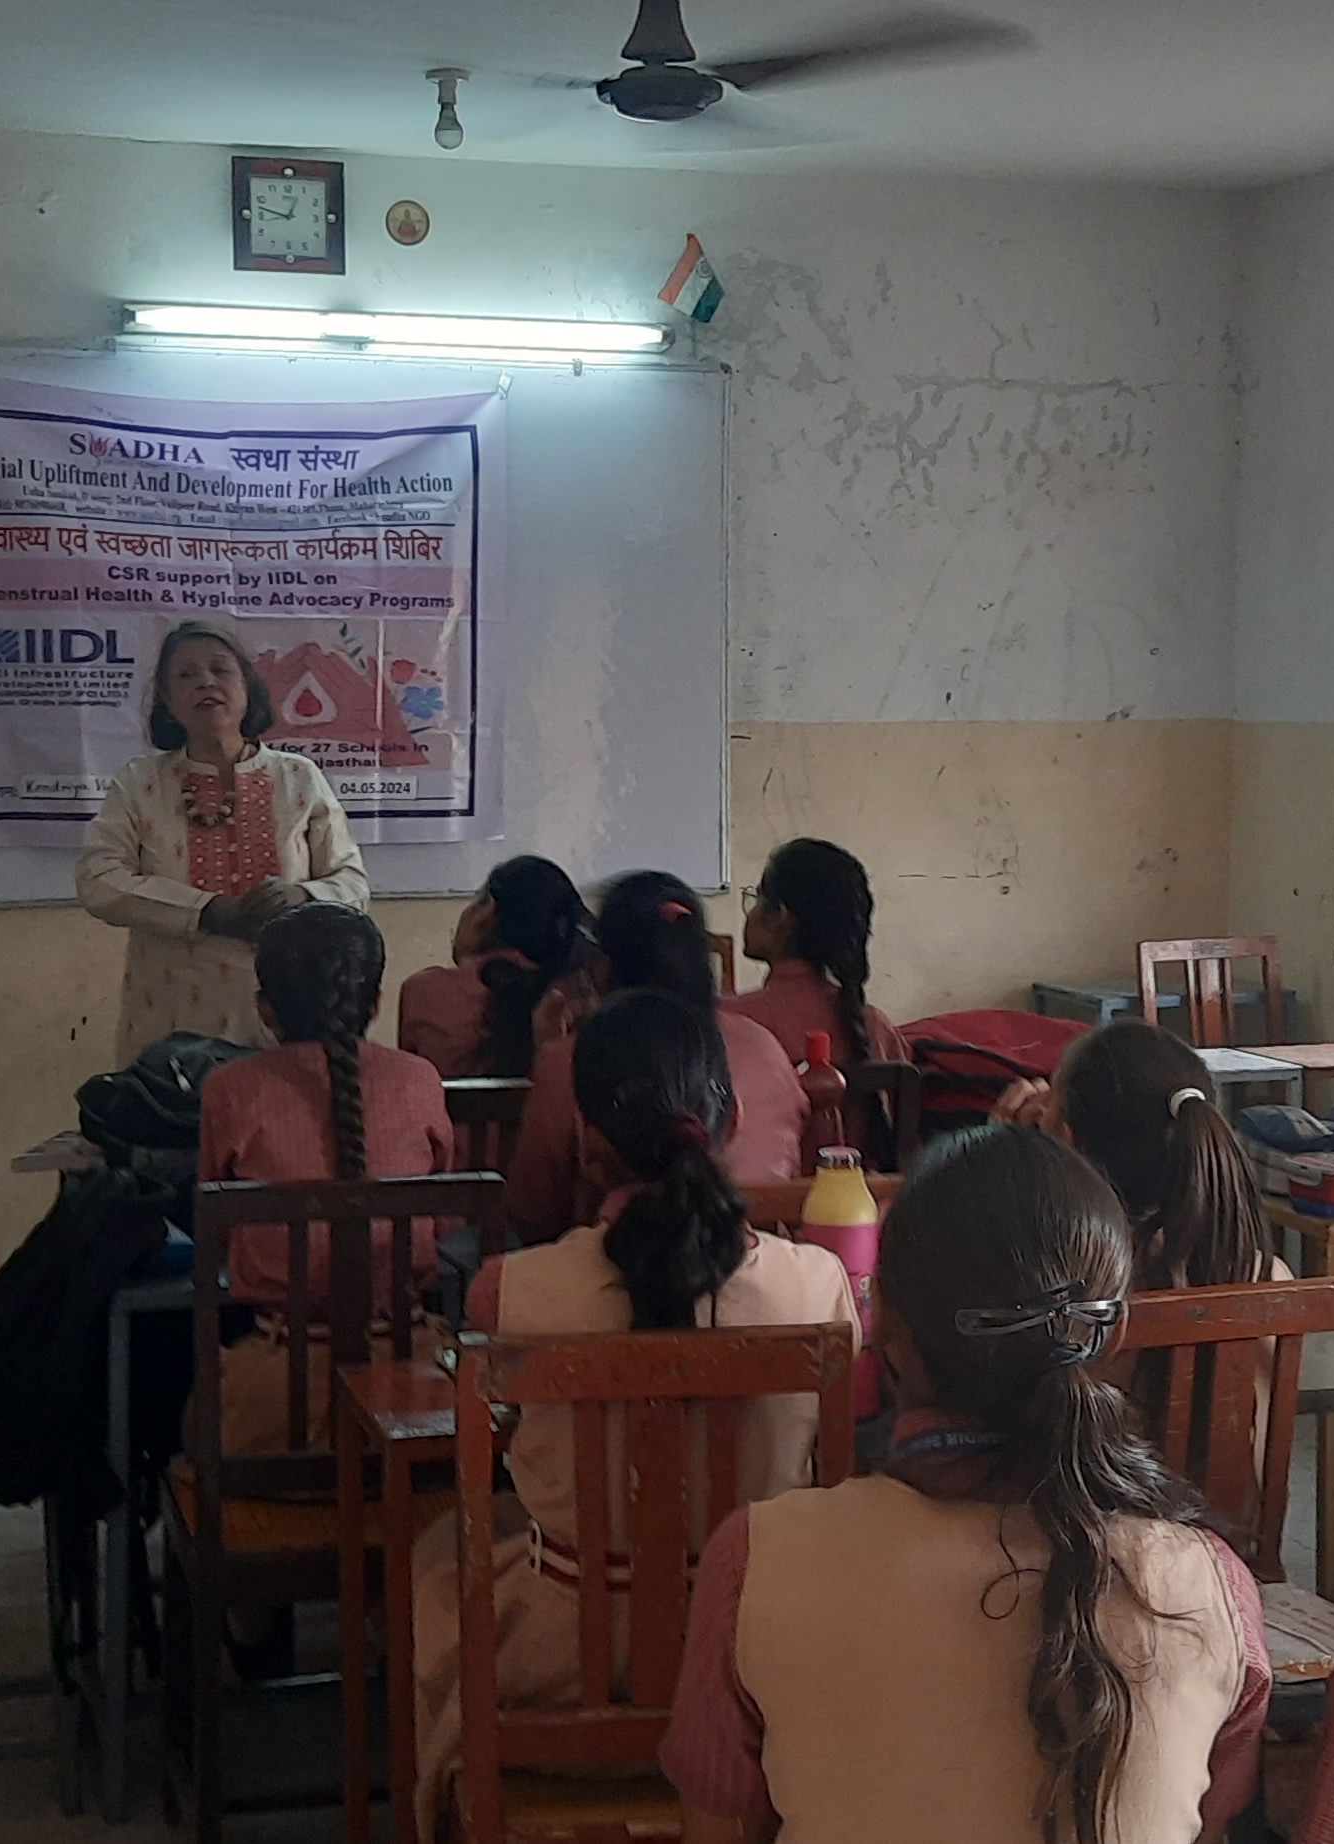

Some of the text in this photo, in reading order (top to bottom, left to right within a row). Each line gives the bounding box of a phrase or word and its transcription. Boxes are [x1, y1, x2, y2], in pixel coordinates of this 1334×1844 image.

[229, 445, 360, 472] स्वधा संस्था
[30, 459, 127, 489] Upliftment
[133, 472, 169, 493] And
[176, 472, 297, 503] Development
[299, 478, 328, 500] For
[333, 474, 391, 499] Health
[395, 472, 453, 495] Action
[56, 524, 88, 556] एवं
[293, 528, 377, 560] कार्यक्रम
[383, 529, 442, 560] शिबिर
[108, 565, 337, 588] CSR support by IIDL on
[86, 587, 153, 602] Health
[160, 590, 174, 604] &
[182, 590, 263, 608] Hygiene
[269, 592, 364, 609] Advocacy
[369, 592, 455, 610] Programs
[25, 629, 135, 663] IIDL
[14, 669, 134, 679] Infrastructure
[311, 743, 331, 753] 27
[340, 782, 411, 794] 04.05.2024
